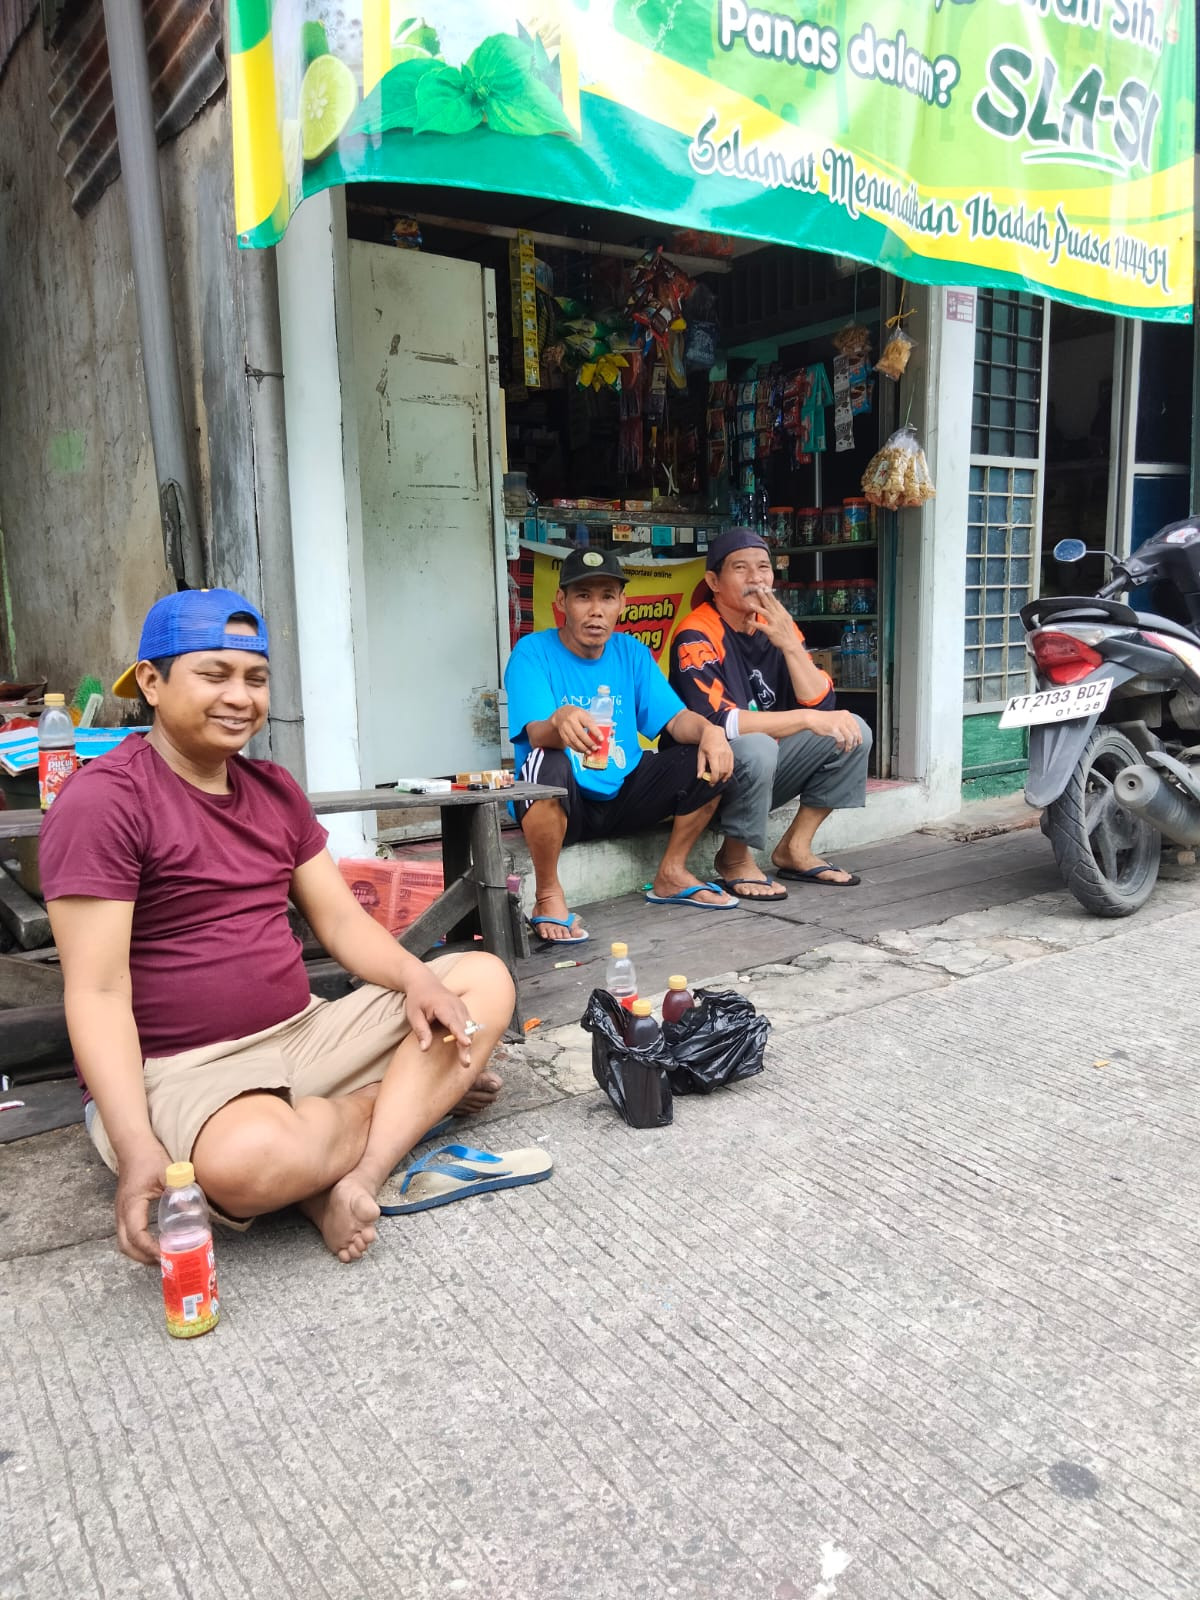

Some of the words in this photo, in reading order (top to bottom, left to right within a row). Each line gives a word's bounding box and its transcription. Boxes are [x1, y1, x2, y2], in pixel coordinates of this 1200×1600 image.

[718, 0, 840, 75] Panas
[848, 22, 961, 108] dalam?
[975, 46, 1160, 170] SLA-SI
[690, 112, 818, 191] Selamat
[822, 147, 958, 235] Menunaikan
[965, 195, 1050, 250] Ibadah
[1049, 205, 1111, 265] Puasa
[1008, 696, 1032, 712] KT
[1032, 689, 1071, 708] 2133
[1076, 681, 1107, 700] BDZ
